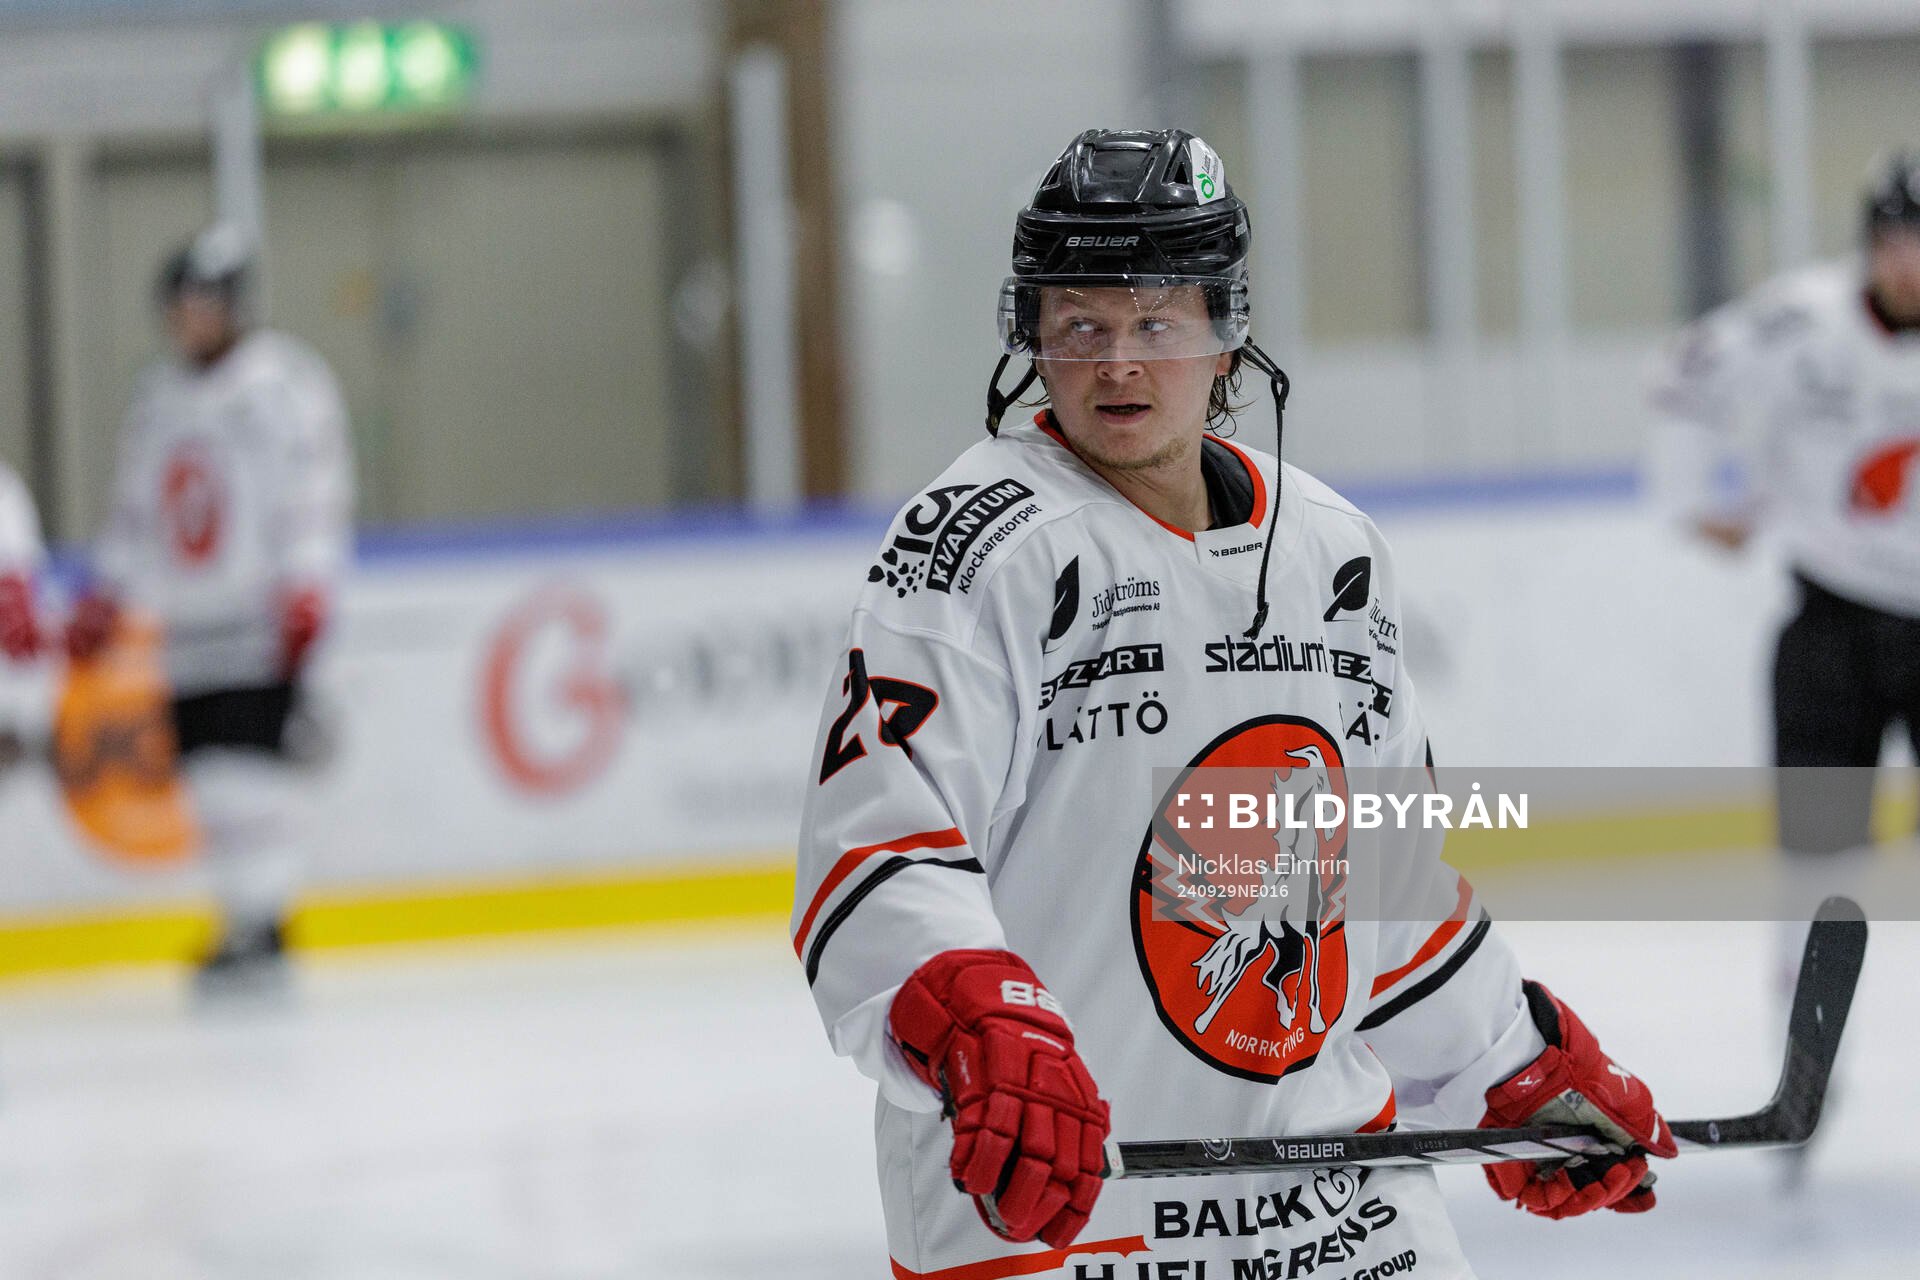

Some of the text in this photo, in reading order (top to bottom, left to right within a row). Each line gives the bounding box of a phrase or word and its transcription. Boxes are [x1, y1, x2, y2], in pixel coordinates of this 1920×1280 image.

[1065, 235, 1140, 247] BAUER
[930, 483, 1025, 585] KVANTUM
[956, 502, 1043, 595] Klockaretorpet
[1221, 541, 1264, 557] BAUER
[1204, 634, 1328, 673] stadium
[1037, 690, 1169, 751] LÄTTÖ
[1225, 1026, 1305, 1059] NORRKING
[1287, 1142, 1345, 1160] BAUER
